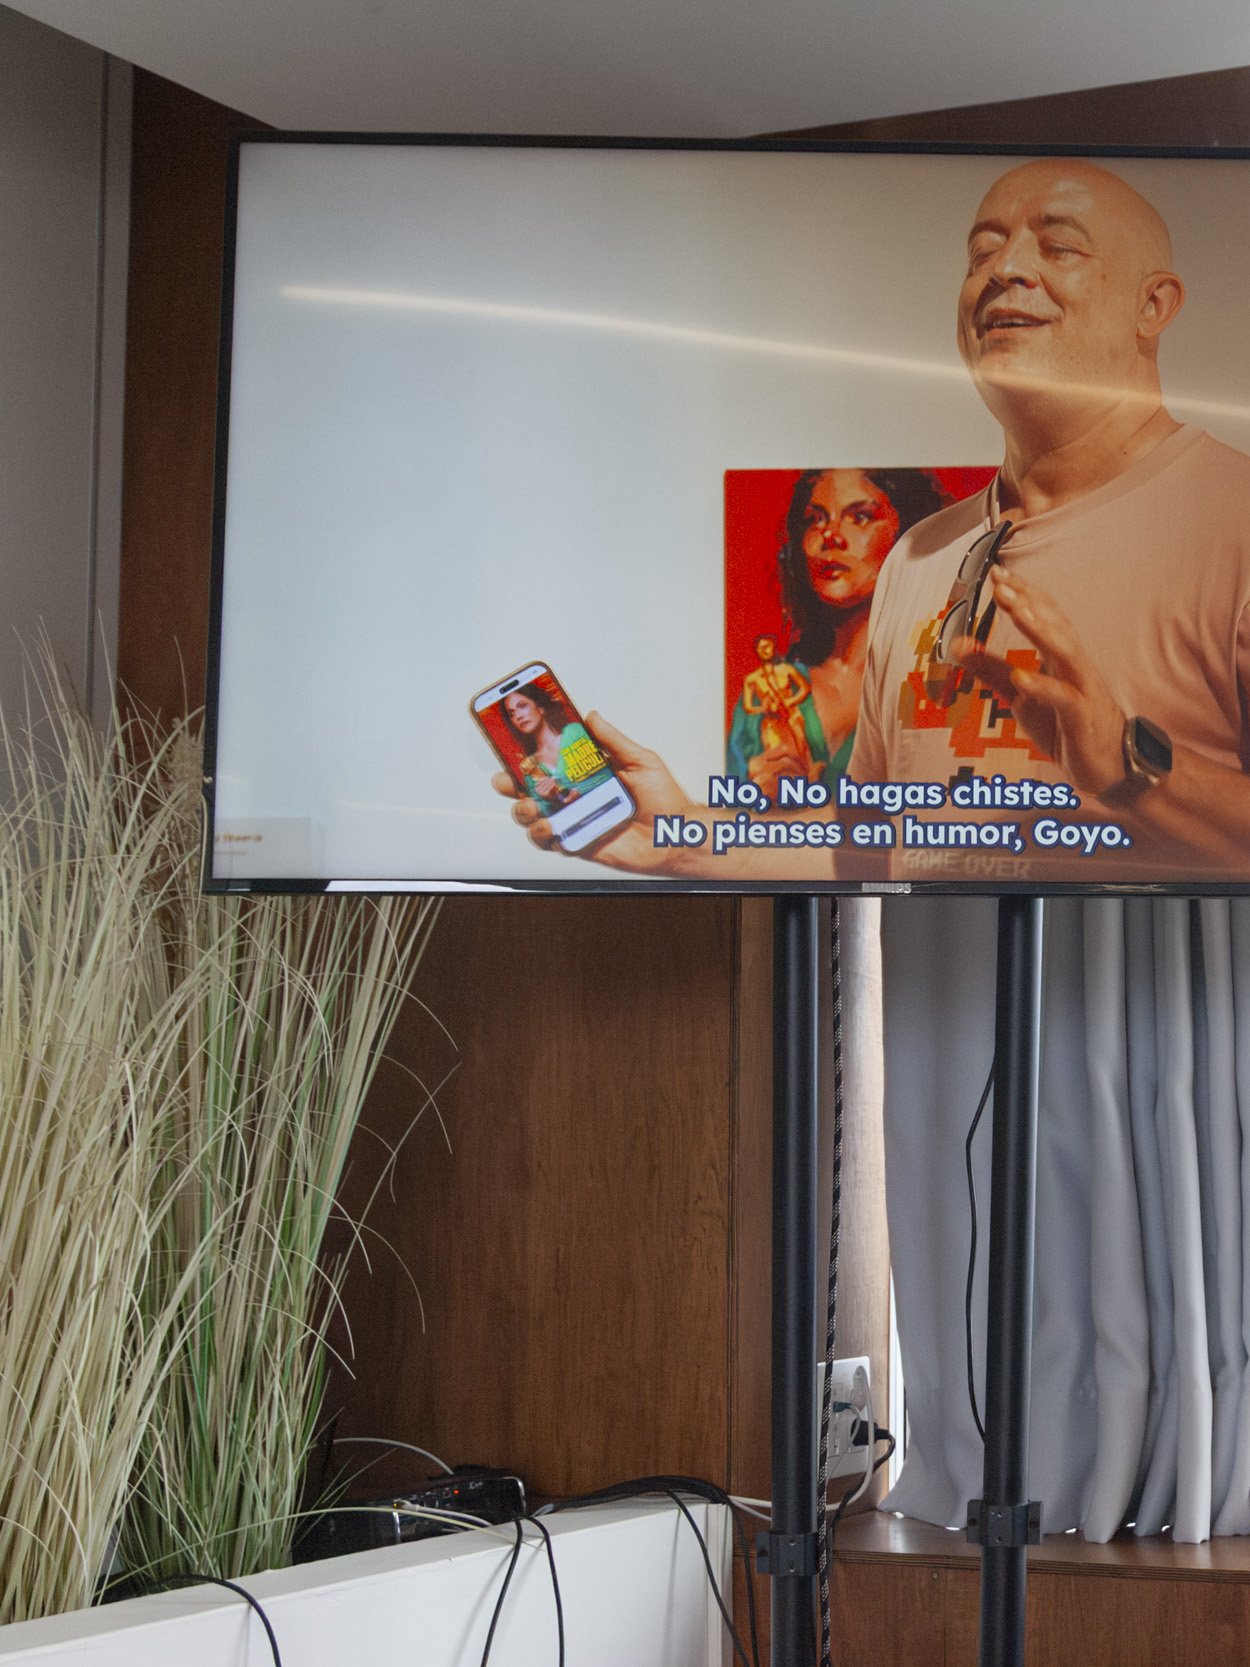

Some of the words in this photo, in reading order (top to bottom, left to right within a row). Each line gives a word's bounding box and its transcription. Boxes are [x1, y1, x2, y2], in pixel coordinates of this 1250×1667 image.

[710, 777, 769, 812] No,
[779, 777, 829, 806] No
[838, 777, 944, 813] hagas
[951, 776, 1078, 807] chistes.
[655, 816, 705, 845] No
[714, 814, 843, 852] pienses
[851, 822, 894, 845] en
[904, 816, 1024, 852] humor,
[1033, 817, 1132, 854] Goyo.
[903, 850, 961, 871] GAME
[964, 854, 1031, 877] OVER
